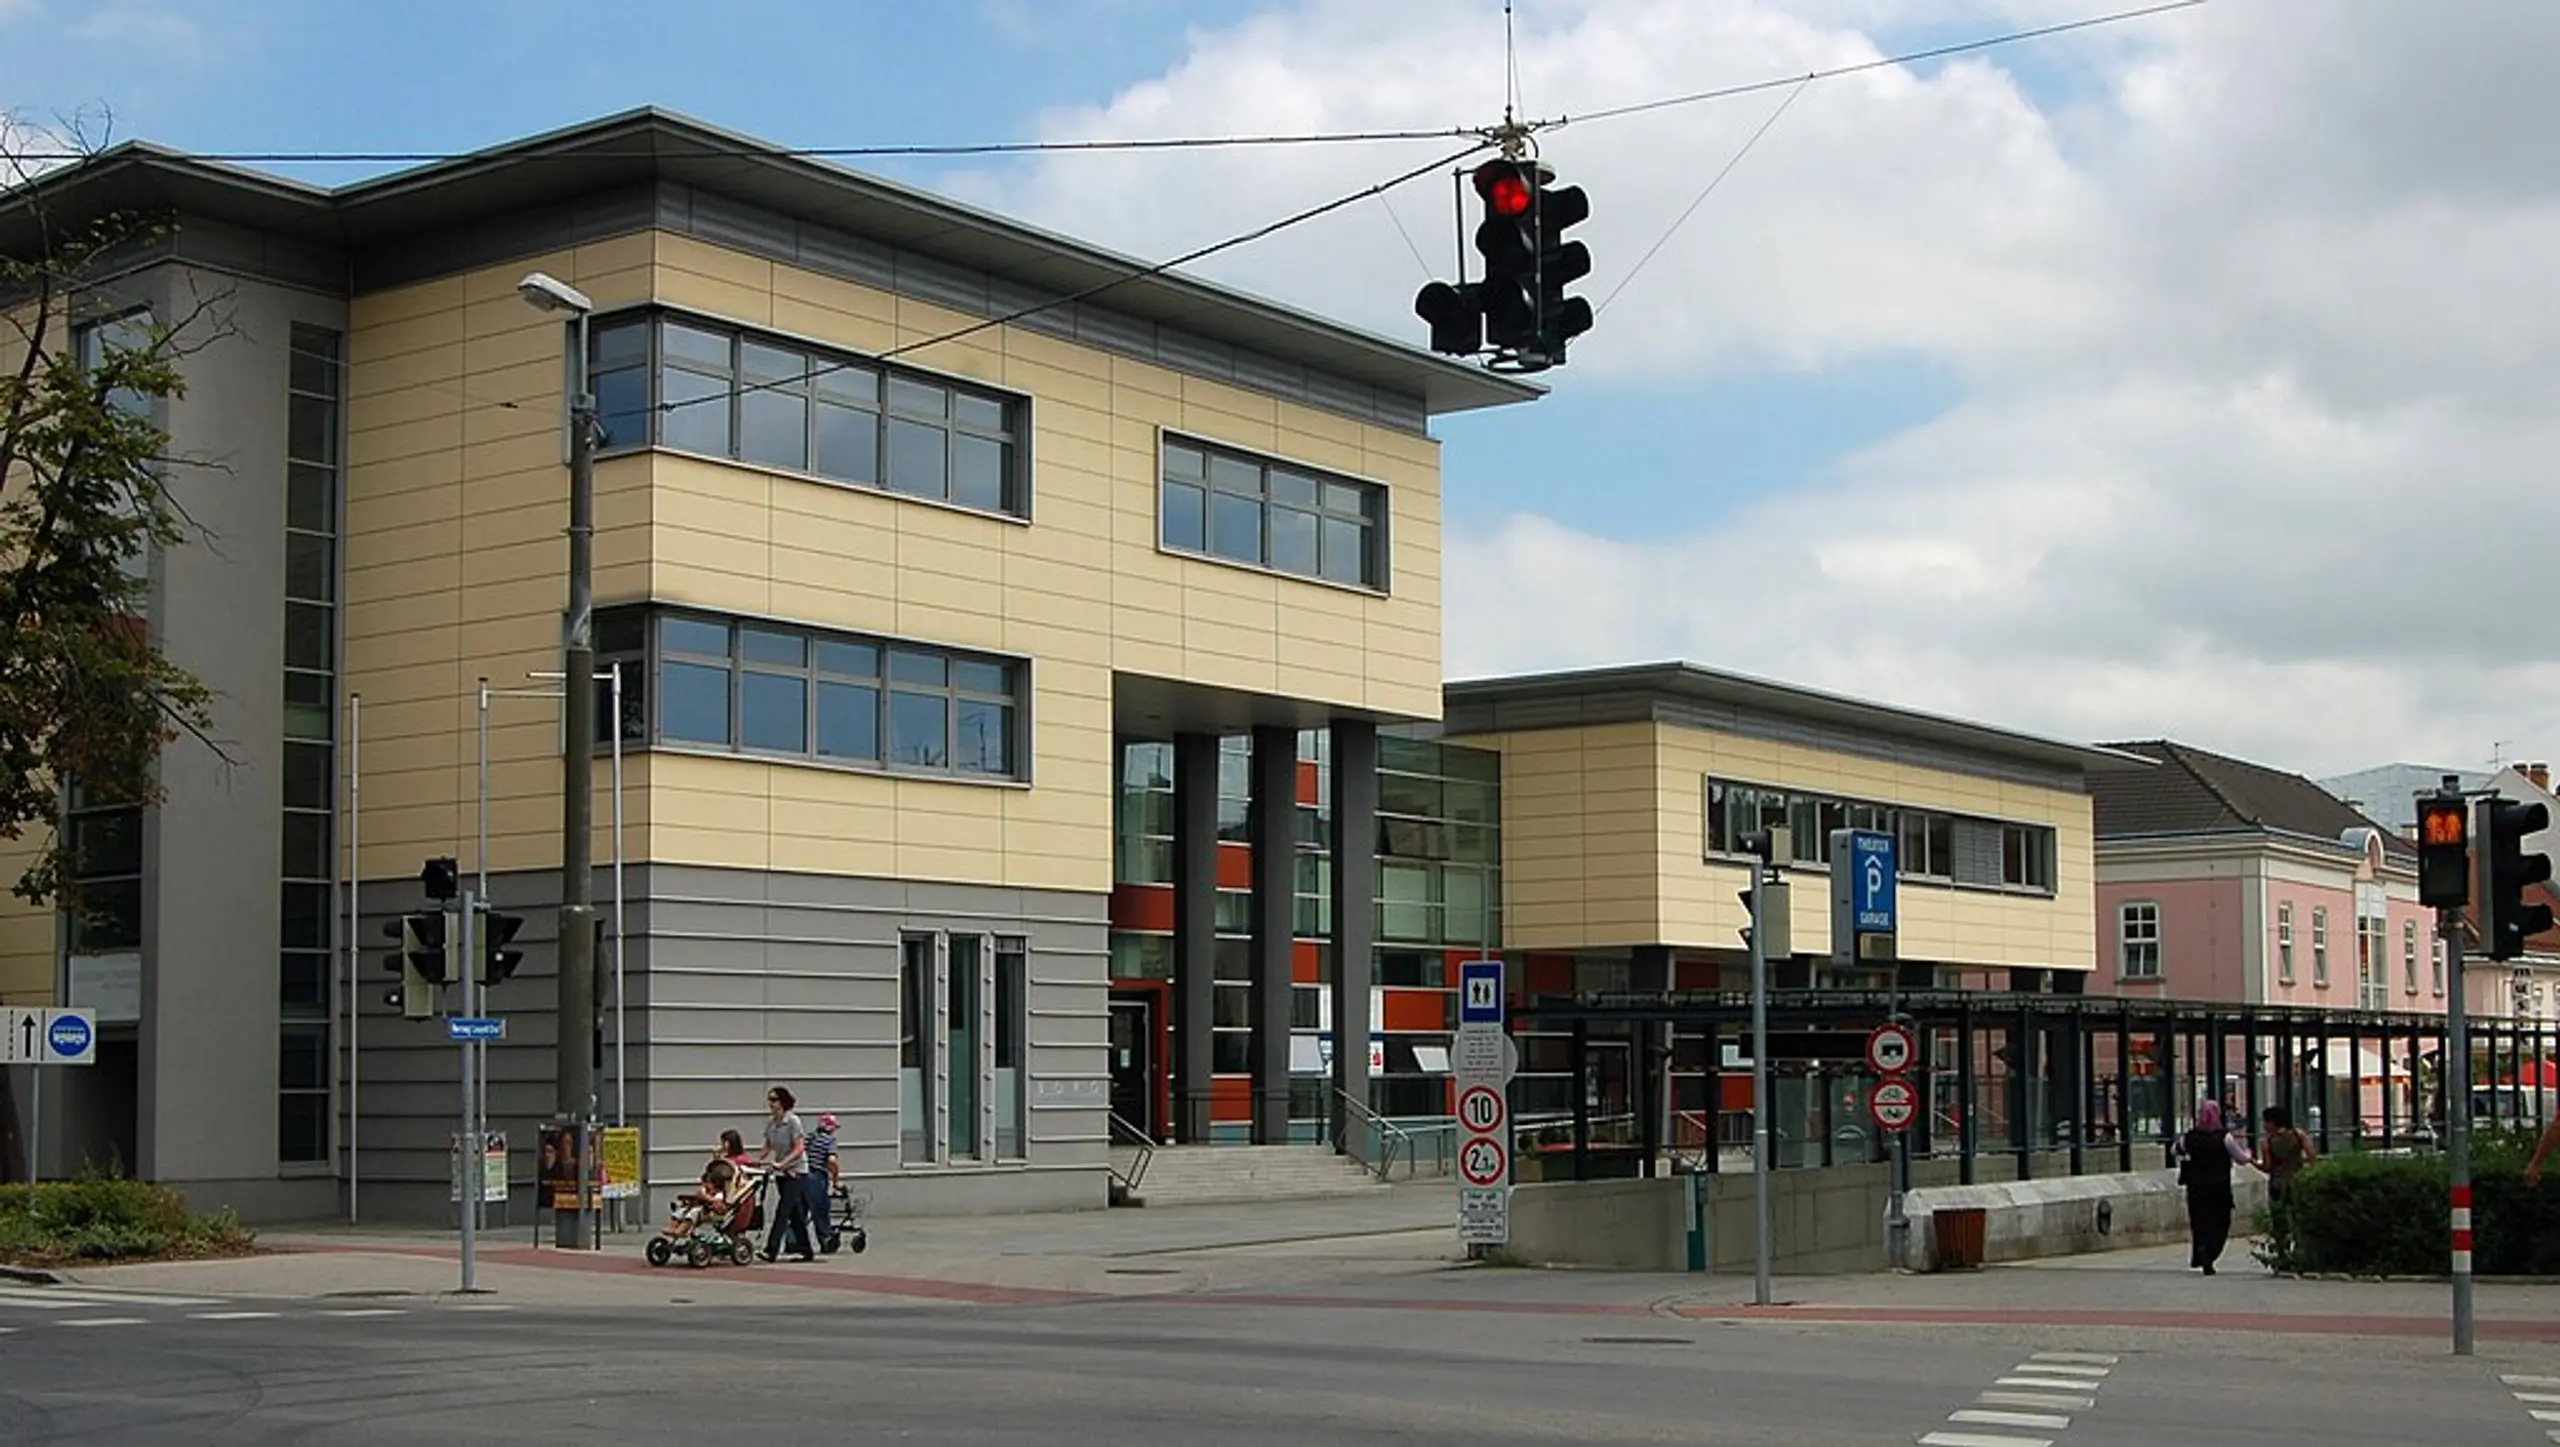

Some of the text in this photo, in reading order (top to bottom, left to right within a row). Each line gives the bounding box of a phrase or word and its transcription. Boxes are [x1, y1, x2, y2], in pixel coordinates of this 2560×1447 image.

[1857, 837, 1889, 852] THEATER
[1866, 867, 1882, 910] P
[1860, 911, 1889, 926] GARAGE
[1469, 1096, 1493, 1124] 10
